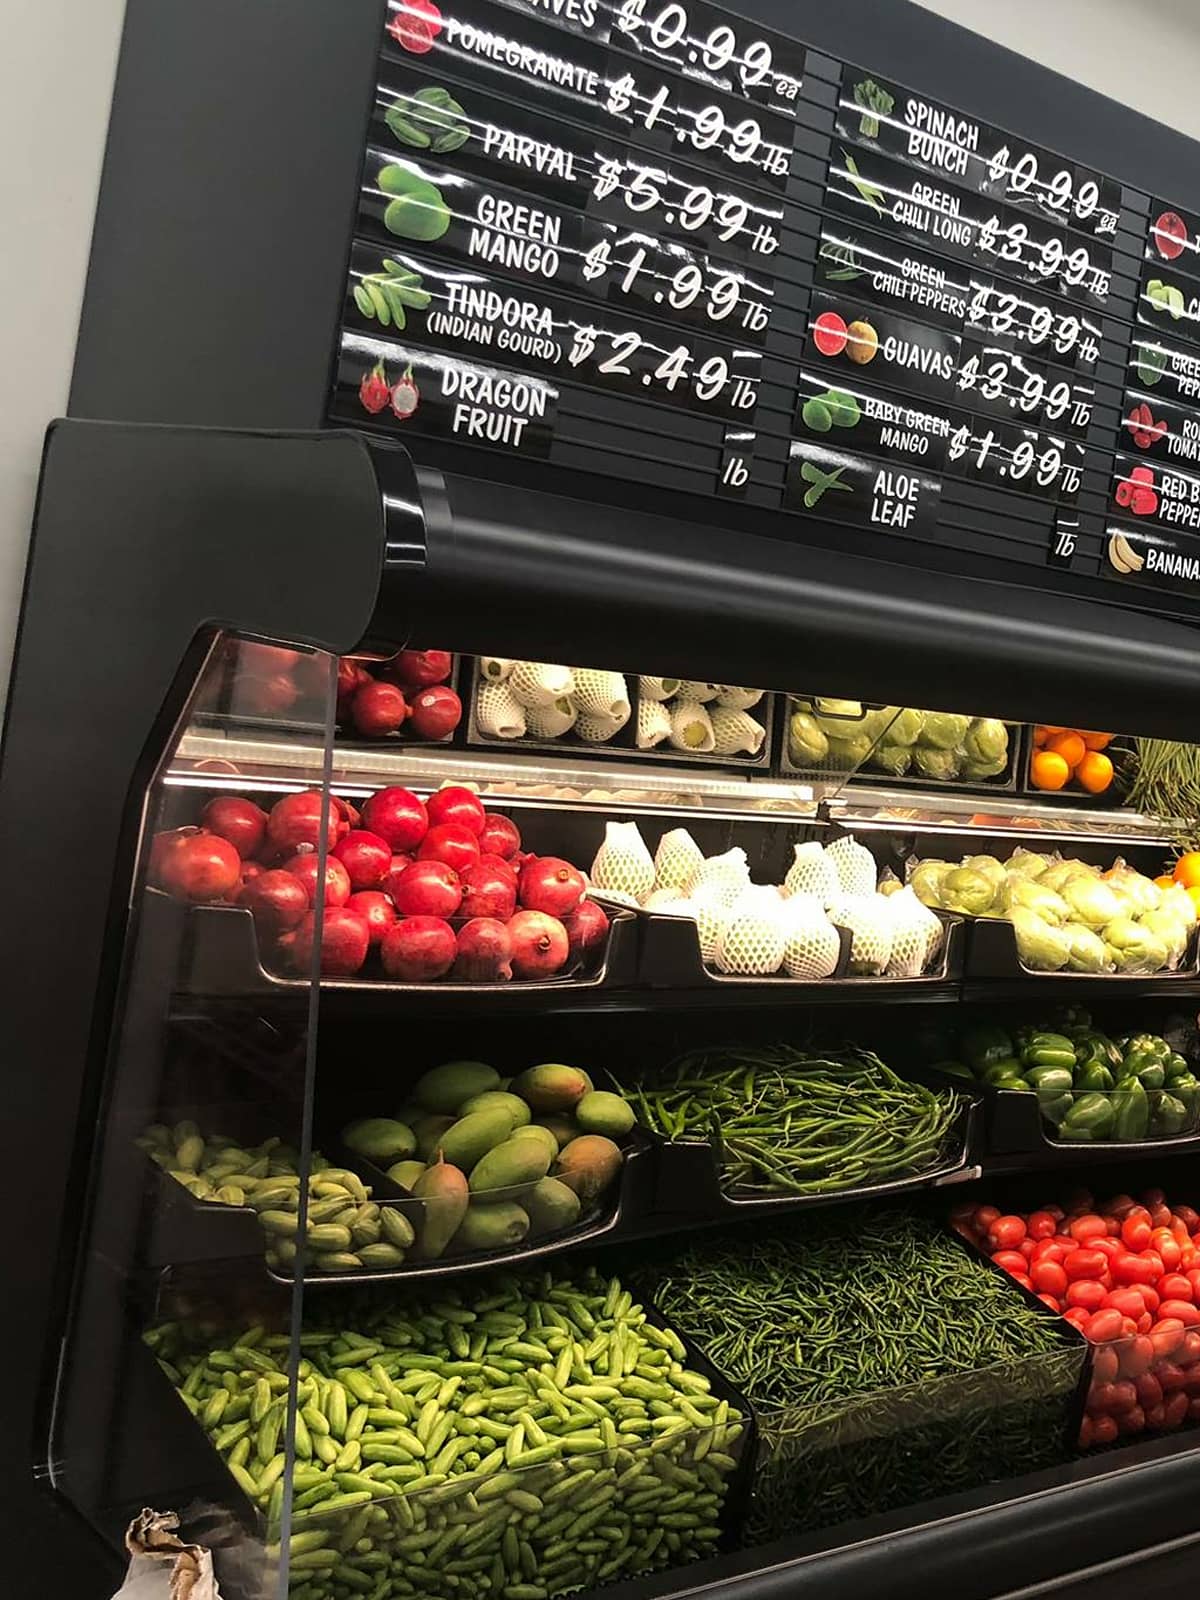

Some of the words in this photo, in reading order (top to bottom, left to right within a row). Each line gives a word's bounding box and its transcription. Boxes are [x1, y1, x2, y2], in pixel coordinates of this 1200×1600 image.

[618, 0, 772, 84] $0.99
[775, 81, 798, 99] ea
[446, 18, 600, 96] POMEGRANATE
[607, 74, 761, 162] $1.99
[763, 144, 790, 175] lb
[904, 99, 979, 150] SPINACH
[989, 146, 1099, 218] $0.99
[1100, 213, 1117, 230] ea
[908, 133, 969, 176] BUNCH
[483, 124, 577, 182] PARVAL
[593, 160, 748, 242] $5.99
[752, 224, 780, 255] lb
[892, 200, 930, 232] CHILI
[933, 216, 972, 247] LONG
[911, 181, 960, 218] GREEN
[978, 215, 1089, 285] $3.99
[1092, 273, 1110, 296] lb
[469, 227, 559, 278] MANGO
[477, 194, 561, 244] GREEN
[582, 239, 740, 320] $1.99
[741, 300, 768, 331] lb
[872, 271, 908, 299] CHILI
[910, 282, 966, 320] PEPPERS
[901, 257, 946, 289] GREEN
[969, 288, 1079, 354] $3.99
[1079, 340, 1099, 363] lb
[426, 316, 494, 348] (INDIAN
[498, 330, 562, 364] GOURD)
[445, 282, 554, 337] TINDORA
[568, 325, 728, 400] $2.49
[731, 378, 756, 409] lb
[441, 369, 546, 417] DRAGON
[882, 335, 953, 379] GUAVAS
[958, 355, 1070, 420] $3.99
[1071, 402, 1092, 426] lb
[452, 407, 529, 447] FRUIT
[865, 398, 902, 425] BABY
[905, 409, 950, 438] GREEN
[949, 425, 1061, 486] $1.99
[1061, 464, 1082, 493] lb
[880, 427, 929, 455] MANGO
[723, 458, 749, 486] lb
[873, 470, 920, 502] ALOE
[1160, 475, 1187, 499] RED
[870, 499, 916, 529] LEAF
[1055, 532, 1077, 557] lb
